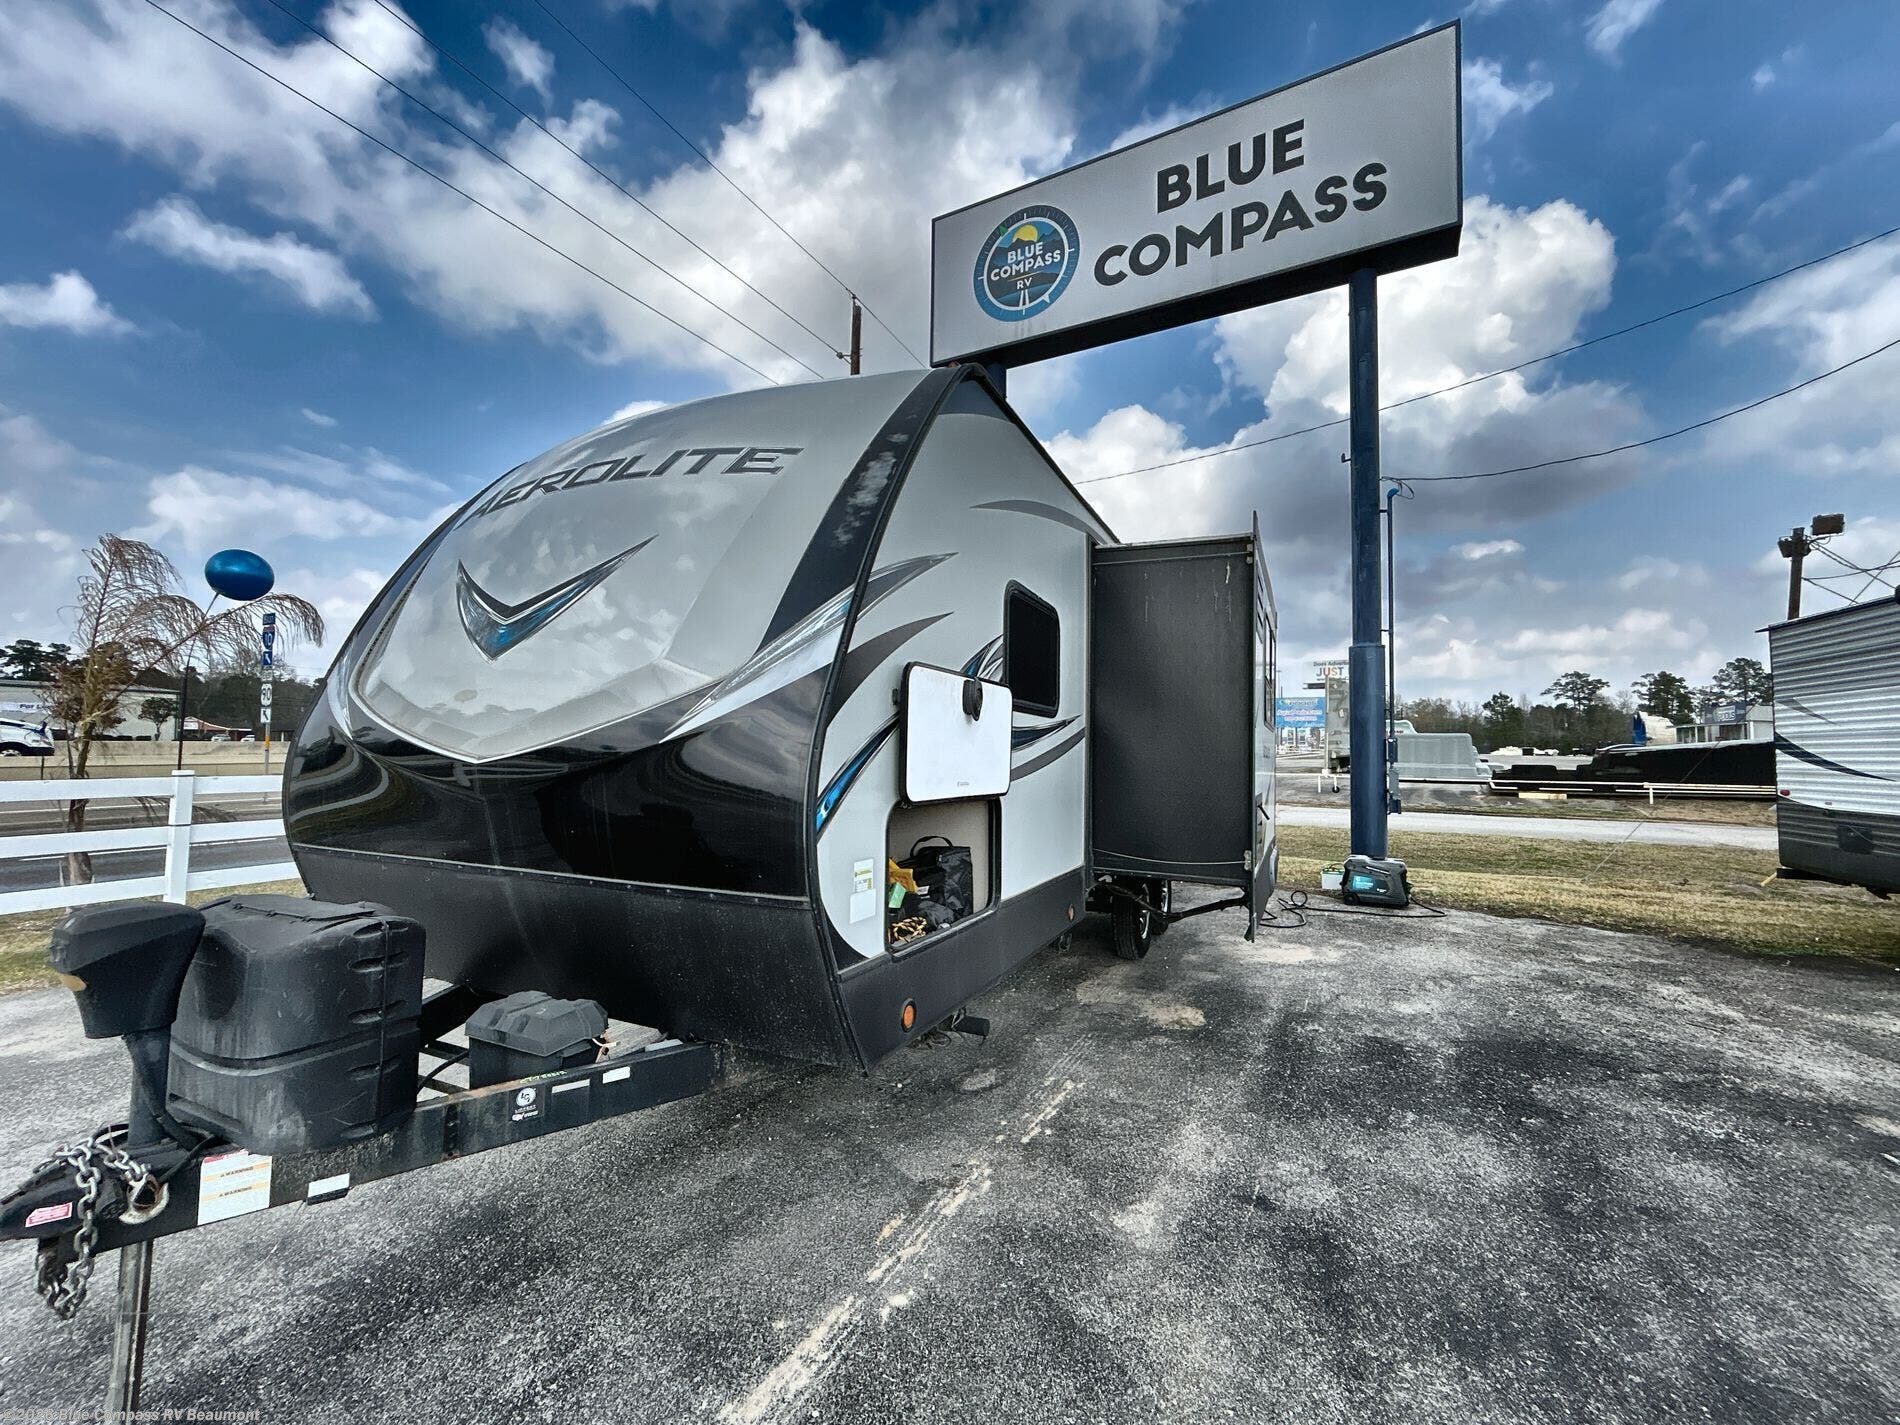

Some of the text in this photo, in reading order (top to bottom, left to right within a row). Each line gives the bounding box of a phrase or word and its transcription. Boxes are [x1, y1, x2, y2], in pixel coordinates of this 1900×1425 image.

[1157, 118, 1305, 214] BLUE
[1094, 162, 1388, 286] COMPASS
[1007, 241, 1043, 264] BLUE
[990, 249, 1061, 281] COMPASS
[1016, 277, 1033, 290] RV
[264, 633, 273, 647] 10
[1316, 666, 1344, 677] JUST
